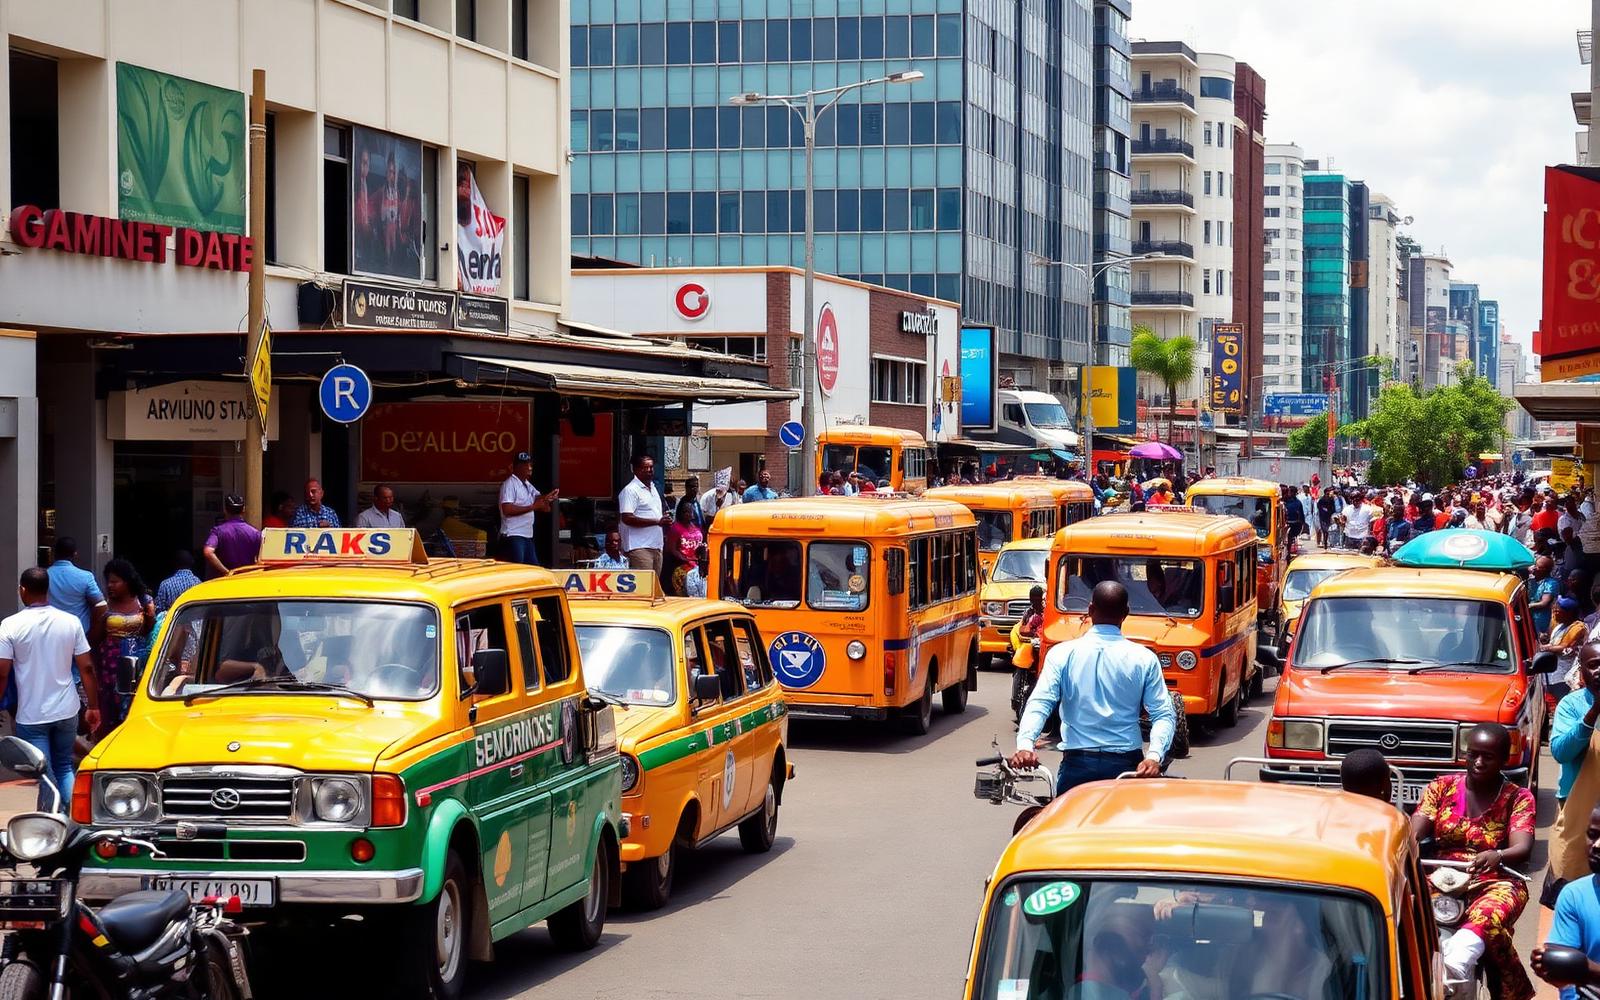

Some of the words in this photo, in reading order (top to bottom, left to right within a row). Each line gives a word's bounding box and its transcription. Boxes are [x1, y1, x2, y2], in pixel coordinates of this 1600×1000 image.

[10, 204, 172, 264] GAMINET
[176, 227, 254, 272] DATE
[334, 376, 360, 410] R
[284, 532, 392, 555] RAKS
[1030, 885, 1075, 912] U59
